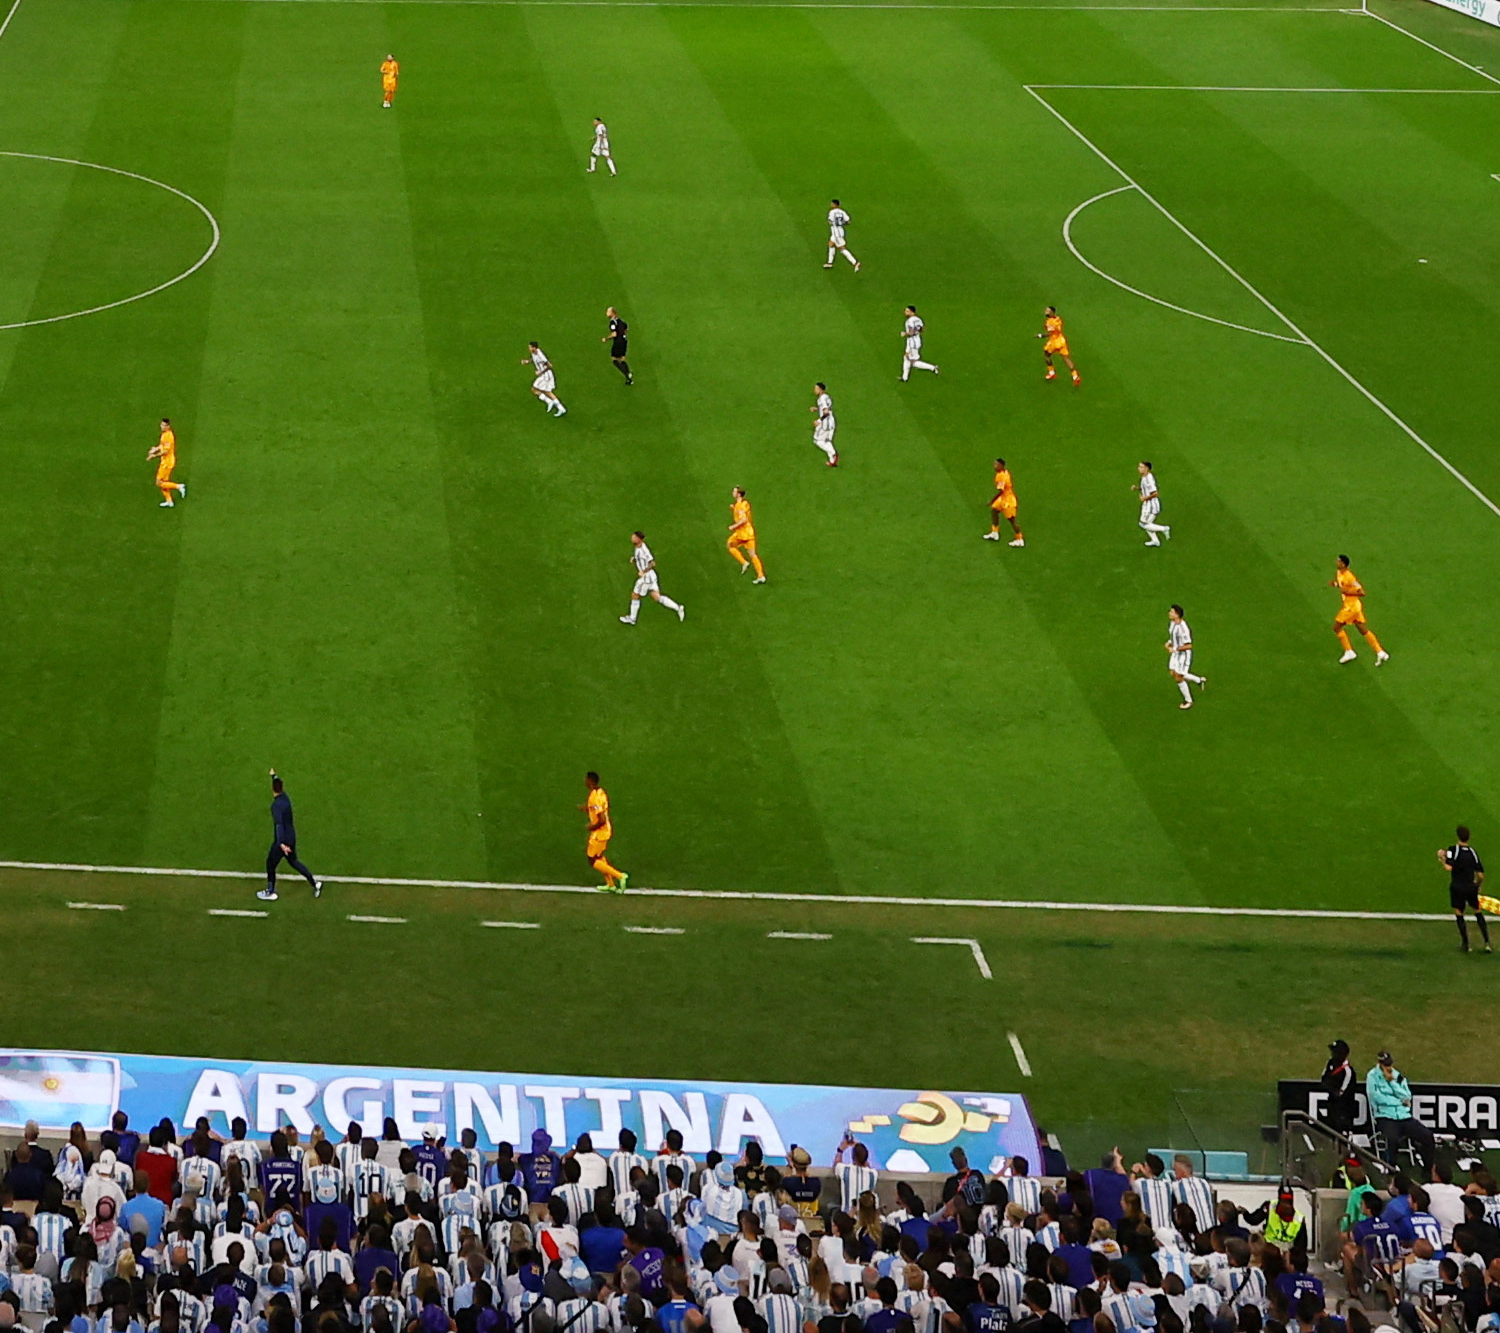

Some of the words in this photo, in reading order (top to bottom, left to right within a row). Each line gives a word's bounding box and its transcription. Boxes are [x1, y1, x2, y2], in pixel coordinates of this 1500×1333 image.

[183, 1068, 788, 1158] ARGENTINA
[268, 1174, 297, 1199] 77
[359, 1173, 383, 1198] 10
[1376, 1233, 1400, 1261] 10
